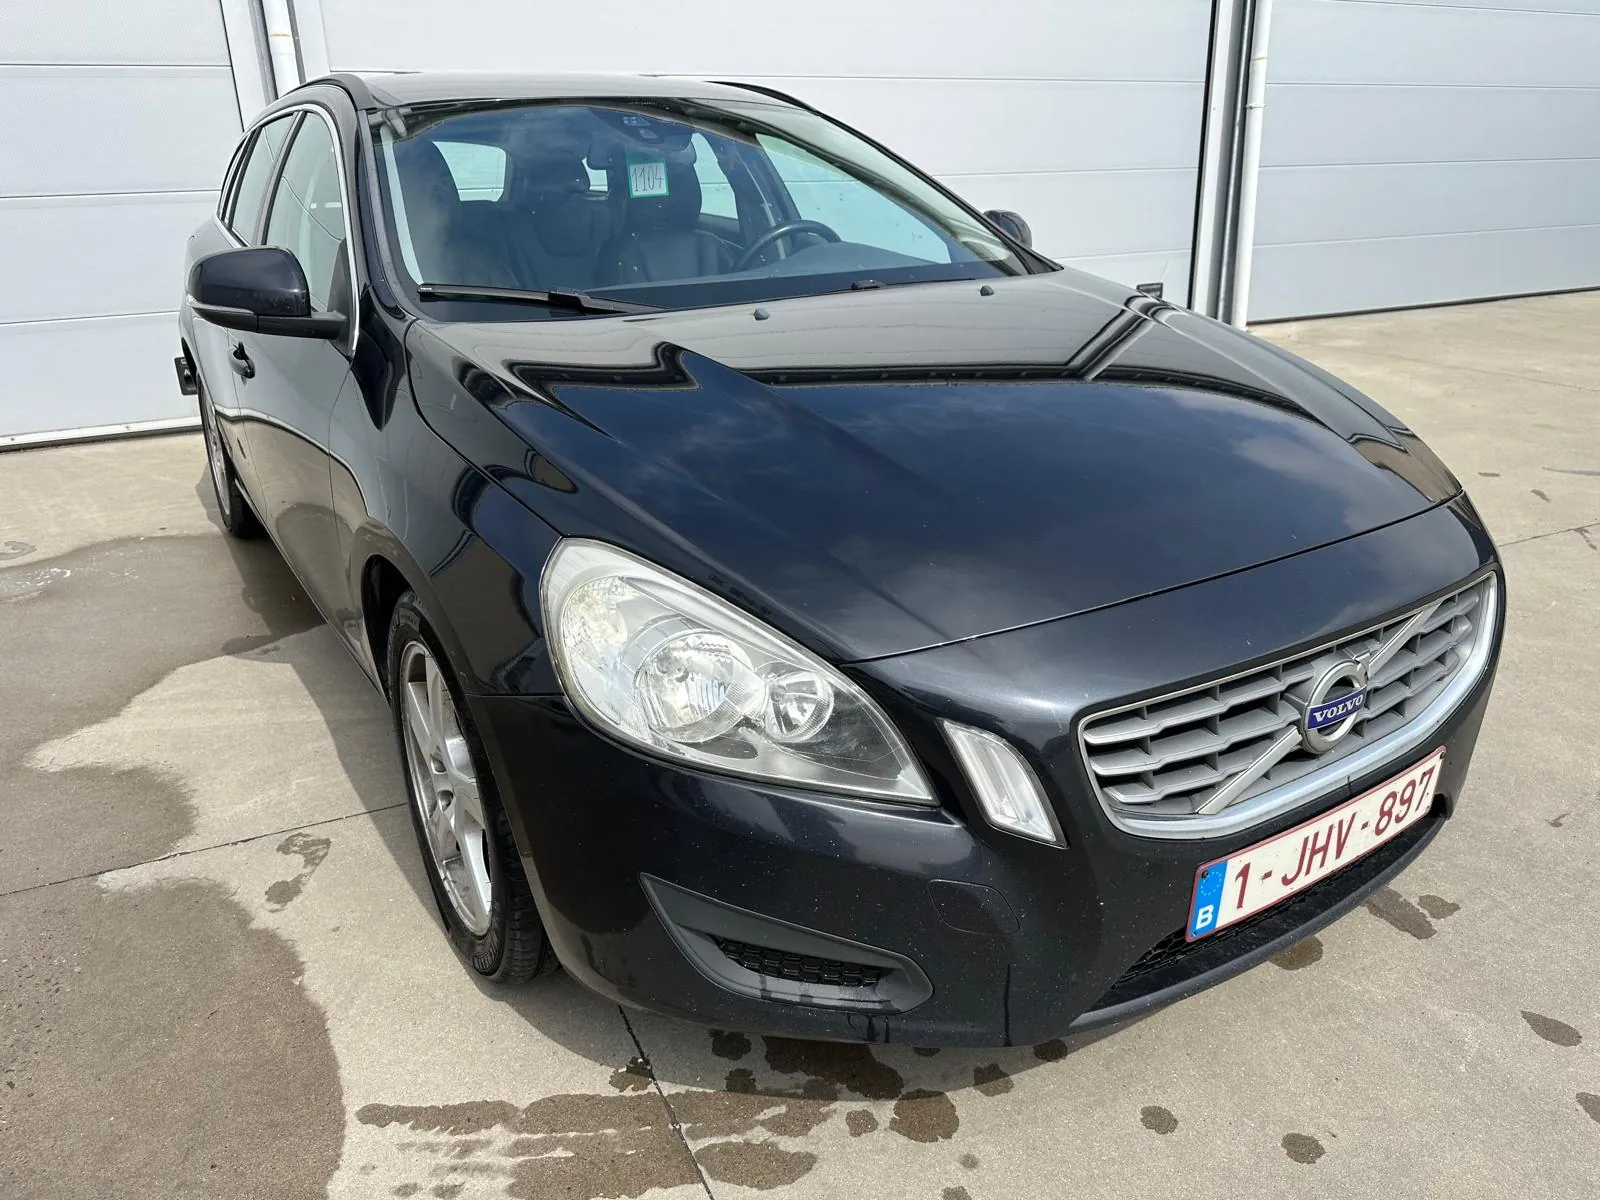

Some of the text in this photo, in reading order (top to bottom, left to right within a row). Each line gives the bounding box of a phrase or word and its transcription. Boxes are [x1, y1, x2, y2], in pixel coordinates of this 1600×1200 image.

[632, 165, 664, 192] 1104
[1313, 694, 1364, 722] VOLVO
[1234, 765, 1436, 910] 1-JHV-897
[1195, 905, 1214, 930] B
